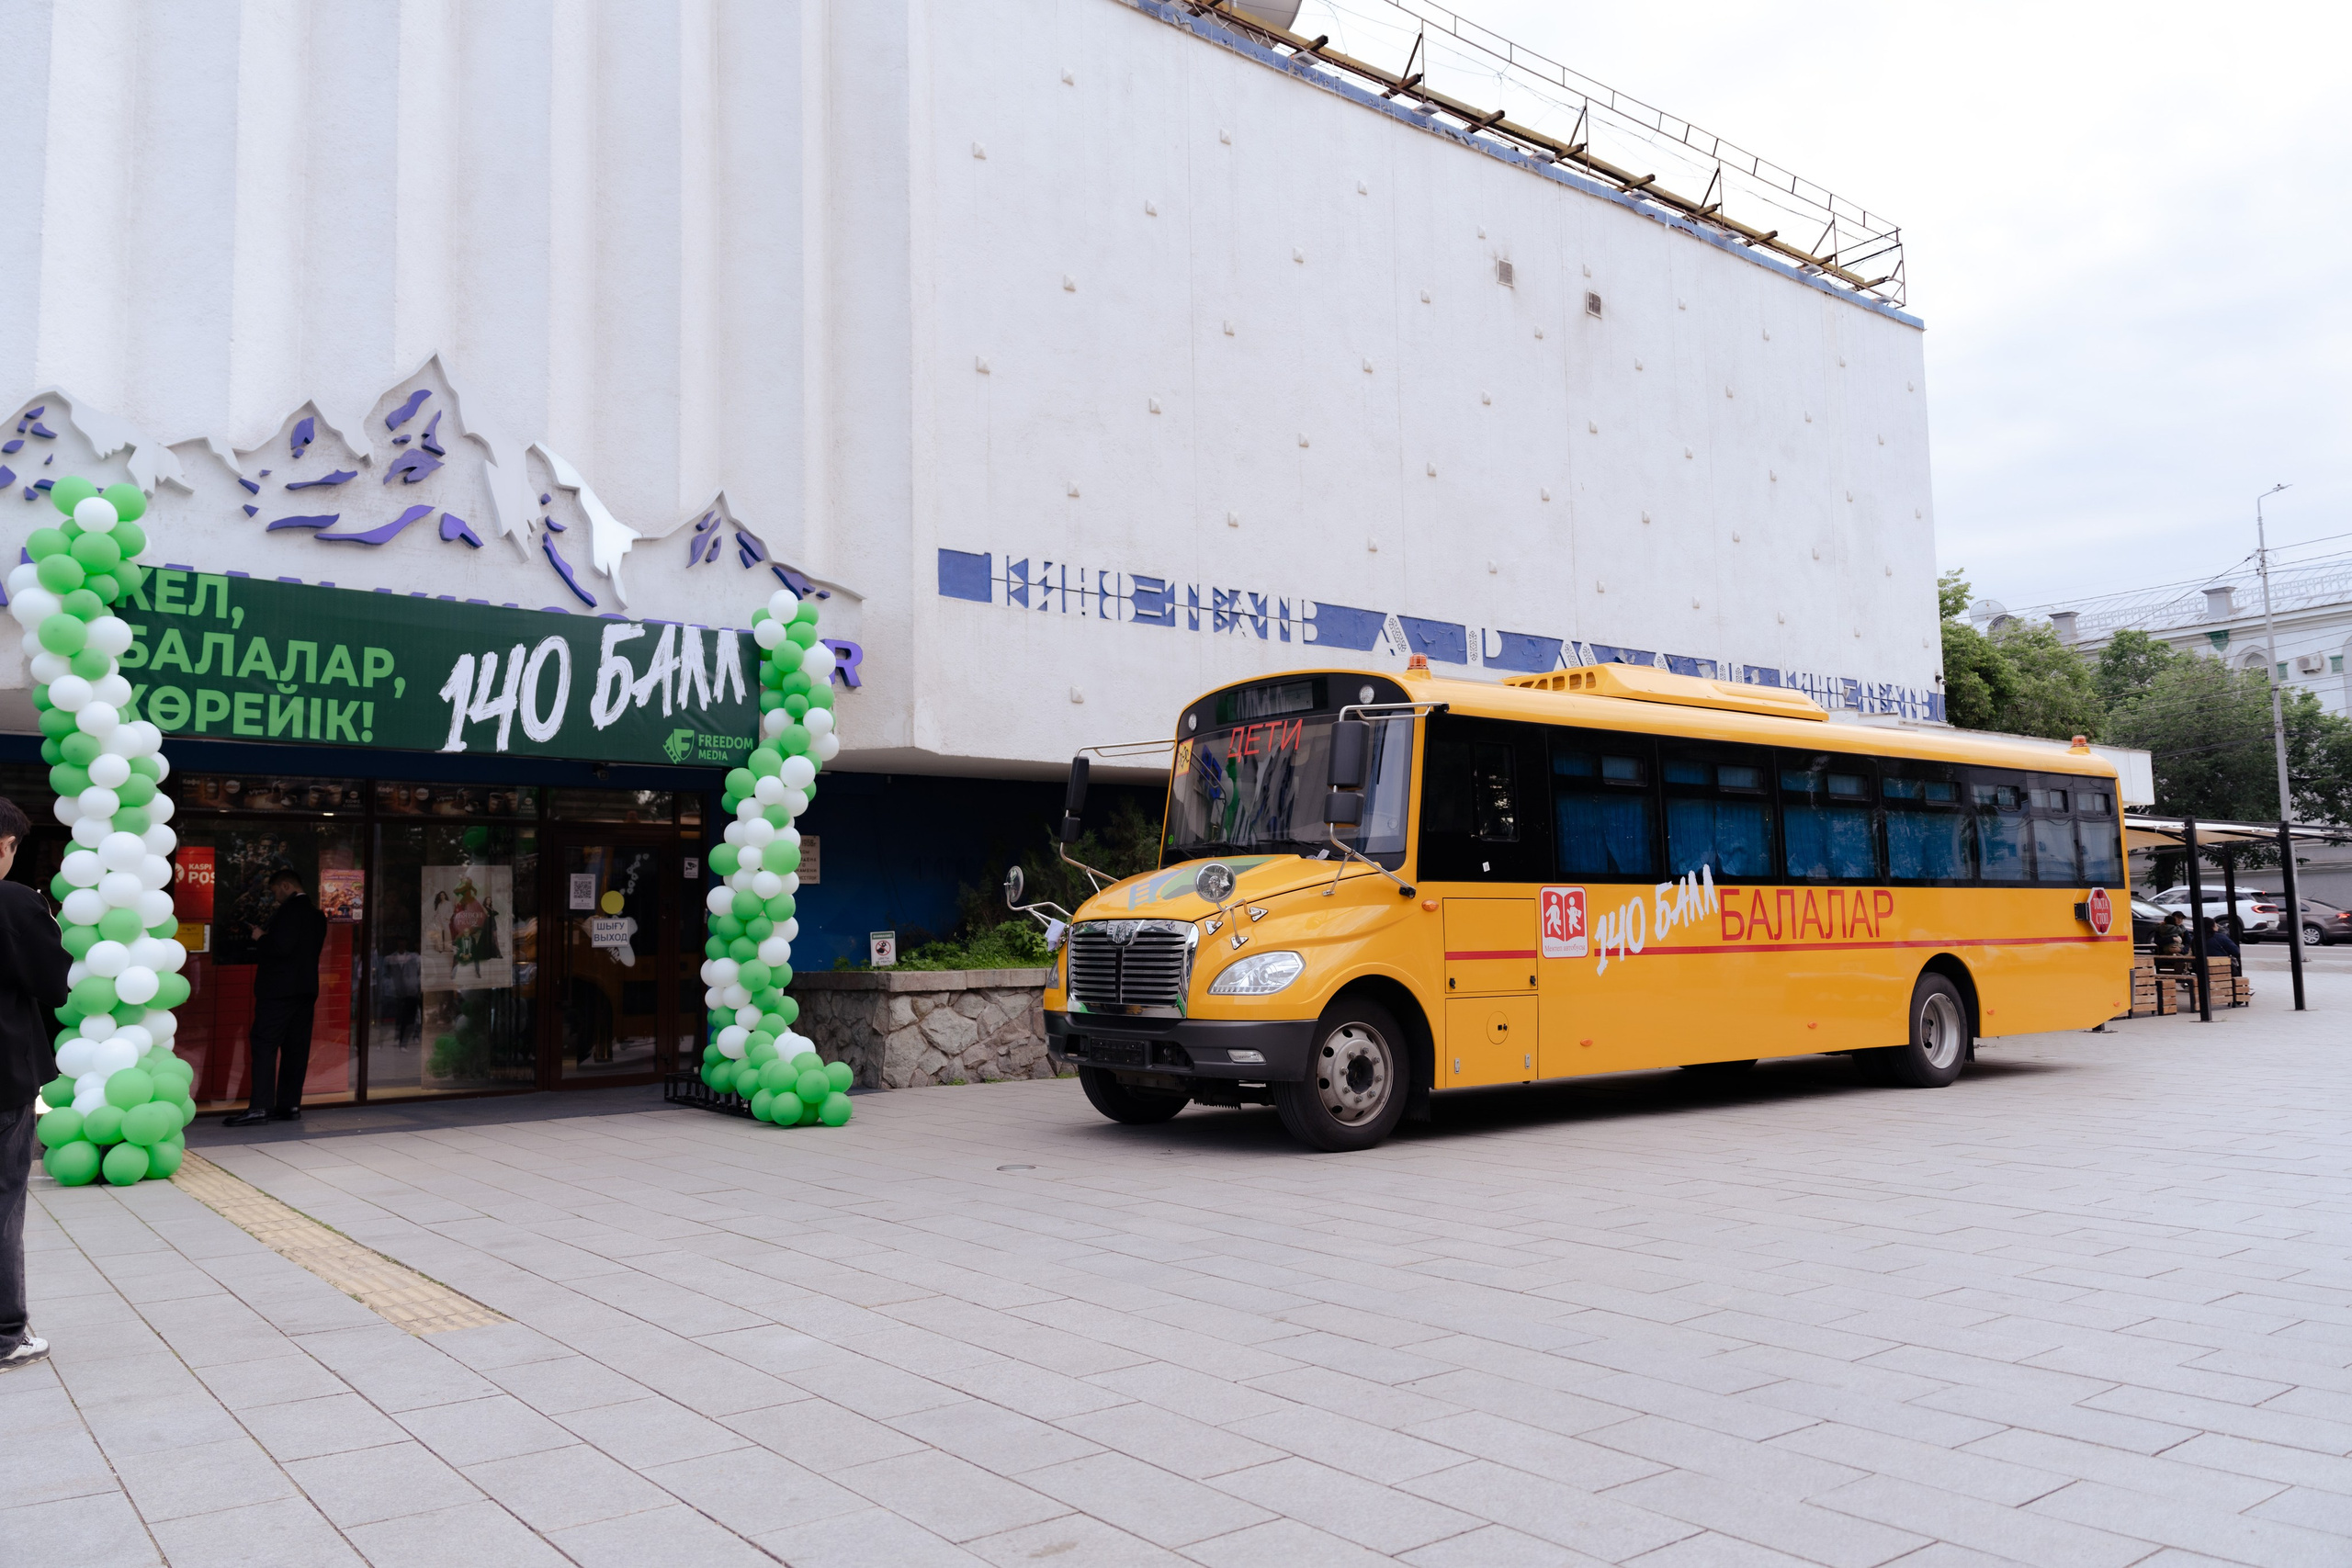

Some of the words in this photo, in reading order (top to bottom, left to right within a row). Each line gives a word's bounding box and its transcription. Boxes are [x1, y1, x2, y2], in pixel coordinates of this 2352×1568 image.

[119, 624, 407, 699] БАЛАЛАР,
[435, 636, 571, 752] 140
[590, 623, 747, 731] БАЛЛ
[698, 734, 753, 750] FREEDOM
[1227, 718, 1304, 762] ДЕТИ
[698, 749, 728, 761] MEDIA
[188, 863, 212, 871] KASPI
[1594, 896, 1645, 976] 140
[1655, 863, 1719, 942] БАЛЛ
[1720, 888, 1894, 942] БАЛАЛАР
[2096, 912, 2109, 925] СТОП
[594, 933, 628, 942] ВЫХОД
